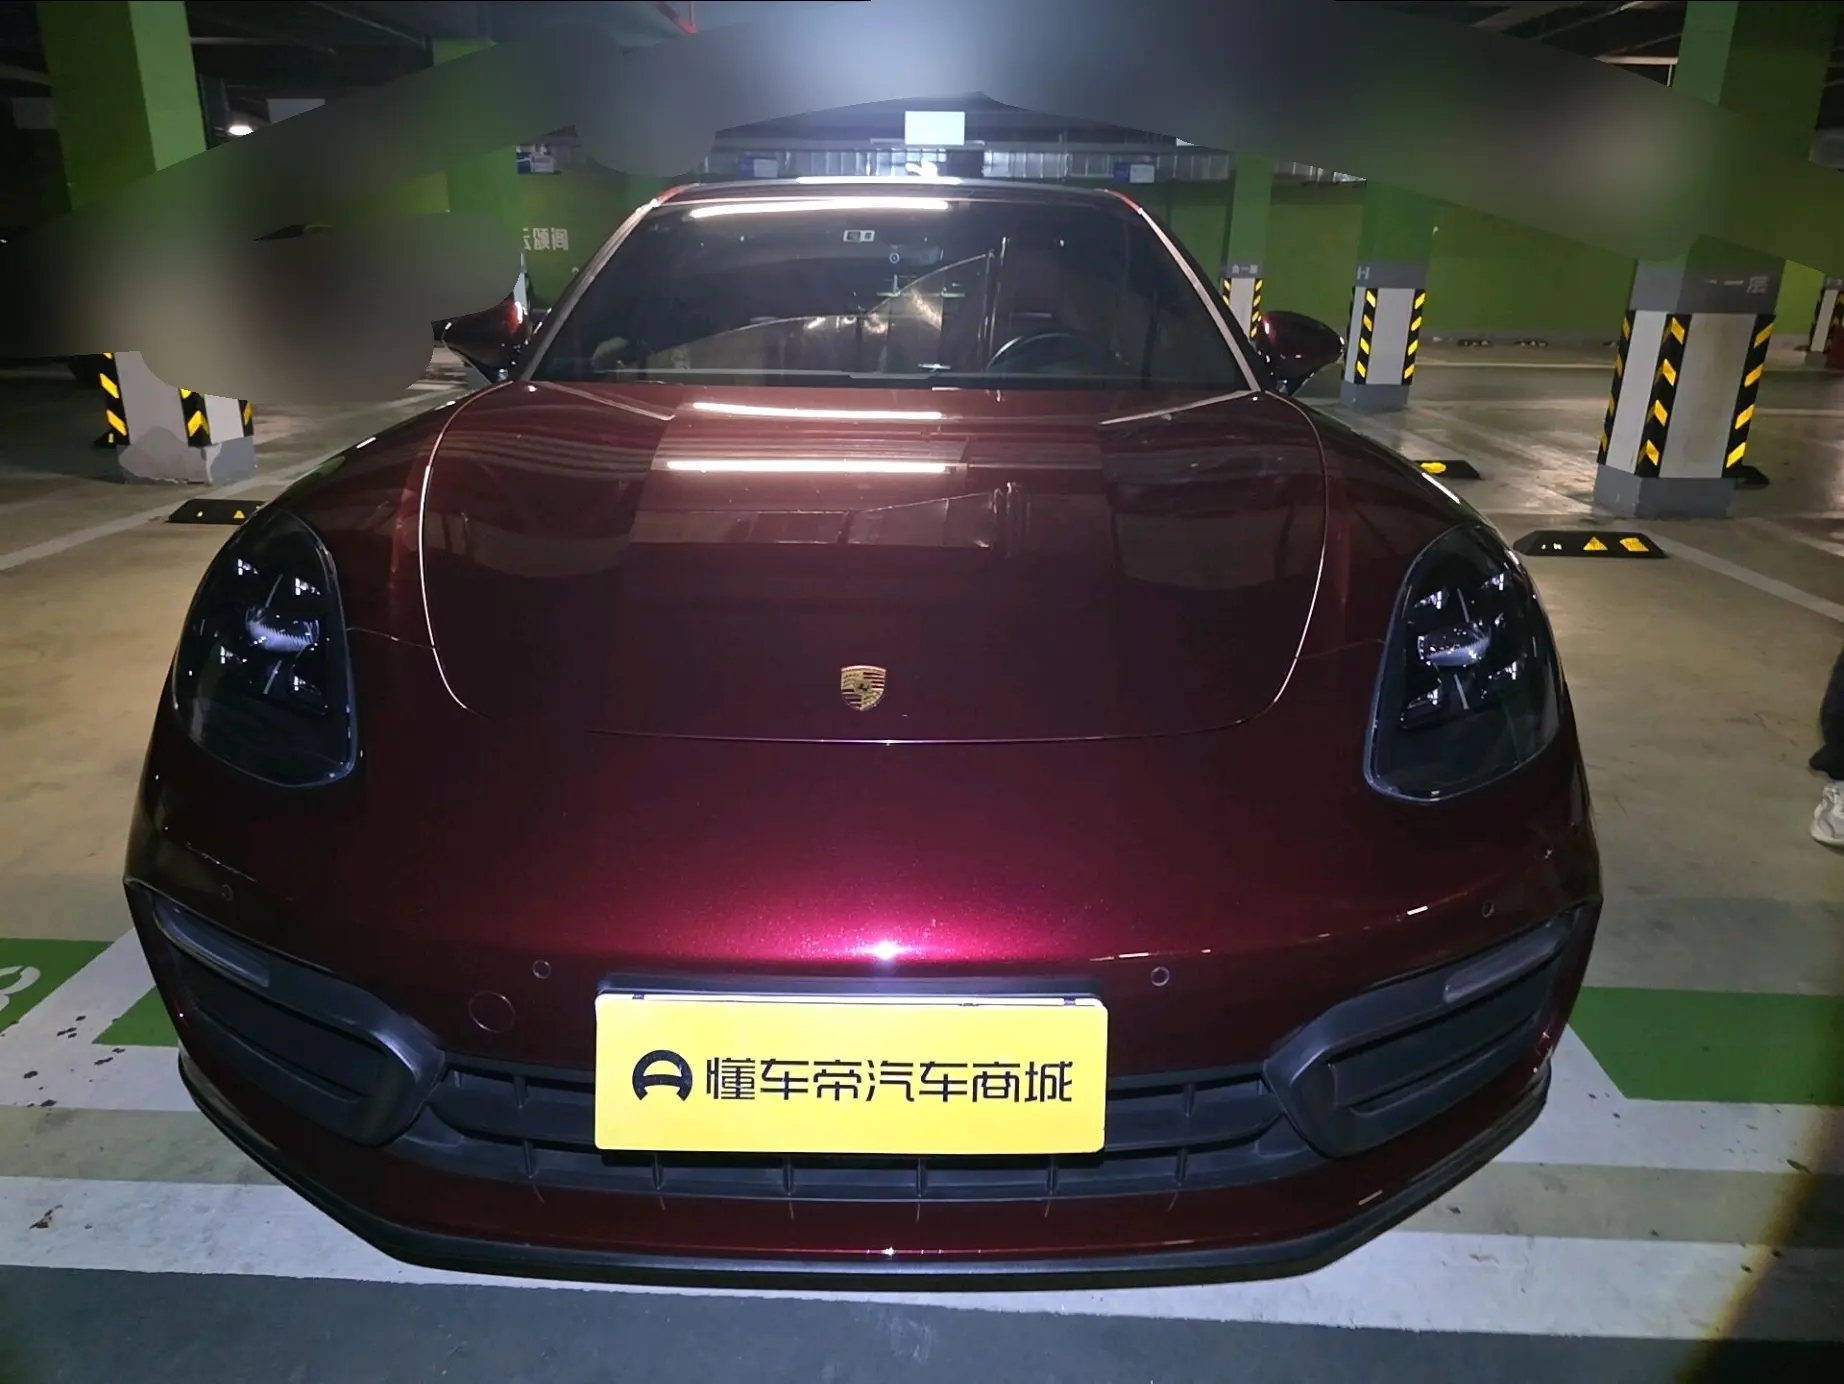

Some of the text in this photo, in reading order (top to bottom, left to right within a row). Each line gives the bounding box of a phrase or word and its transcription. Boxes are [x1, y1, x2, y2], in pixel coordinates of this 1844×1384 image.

[705, 1056, 1073, 1104] 懂车帝汽车商城
